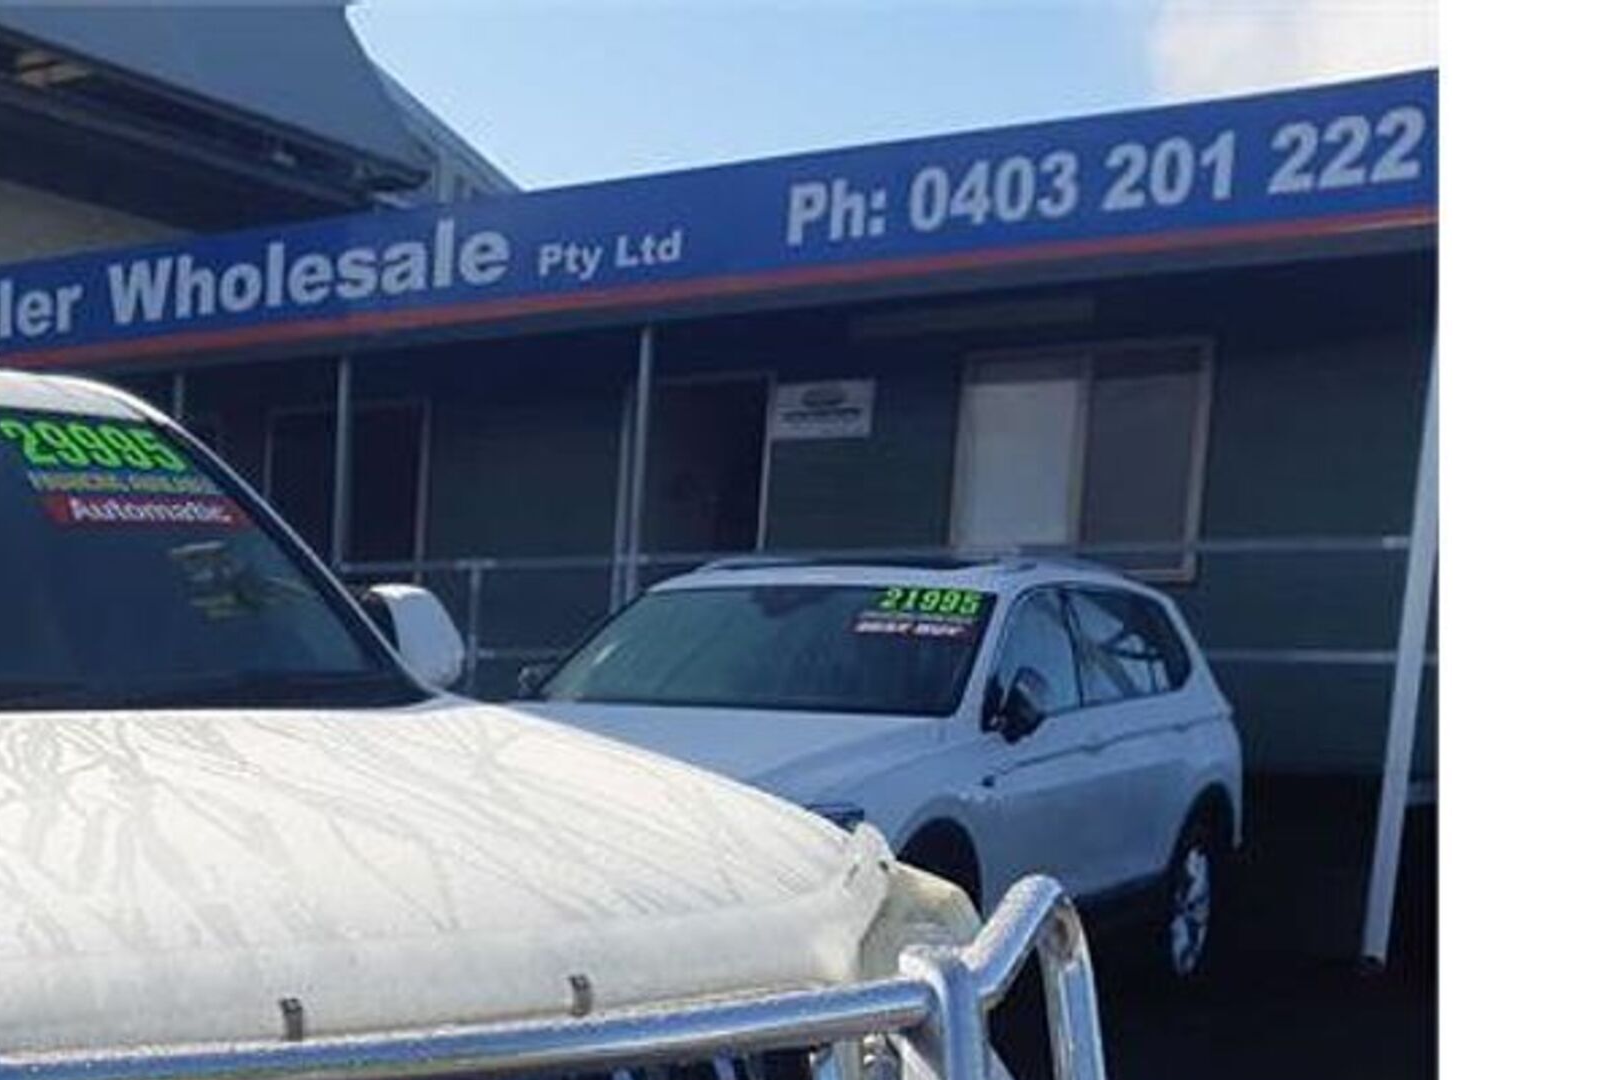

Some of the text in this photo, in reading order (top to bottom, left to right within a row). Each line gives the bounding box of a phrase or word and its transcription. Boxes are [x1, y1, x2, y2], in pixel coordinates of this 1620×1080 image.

[786, 106, 1427, 246] Ph: 0403 201 222
[107, 219, 511, 326] Wholesale
[537, 240, 601, 281] Pty
[615, 231, 683, 271] Ltd
[880, 587, 981, 614] 21995
